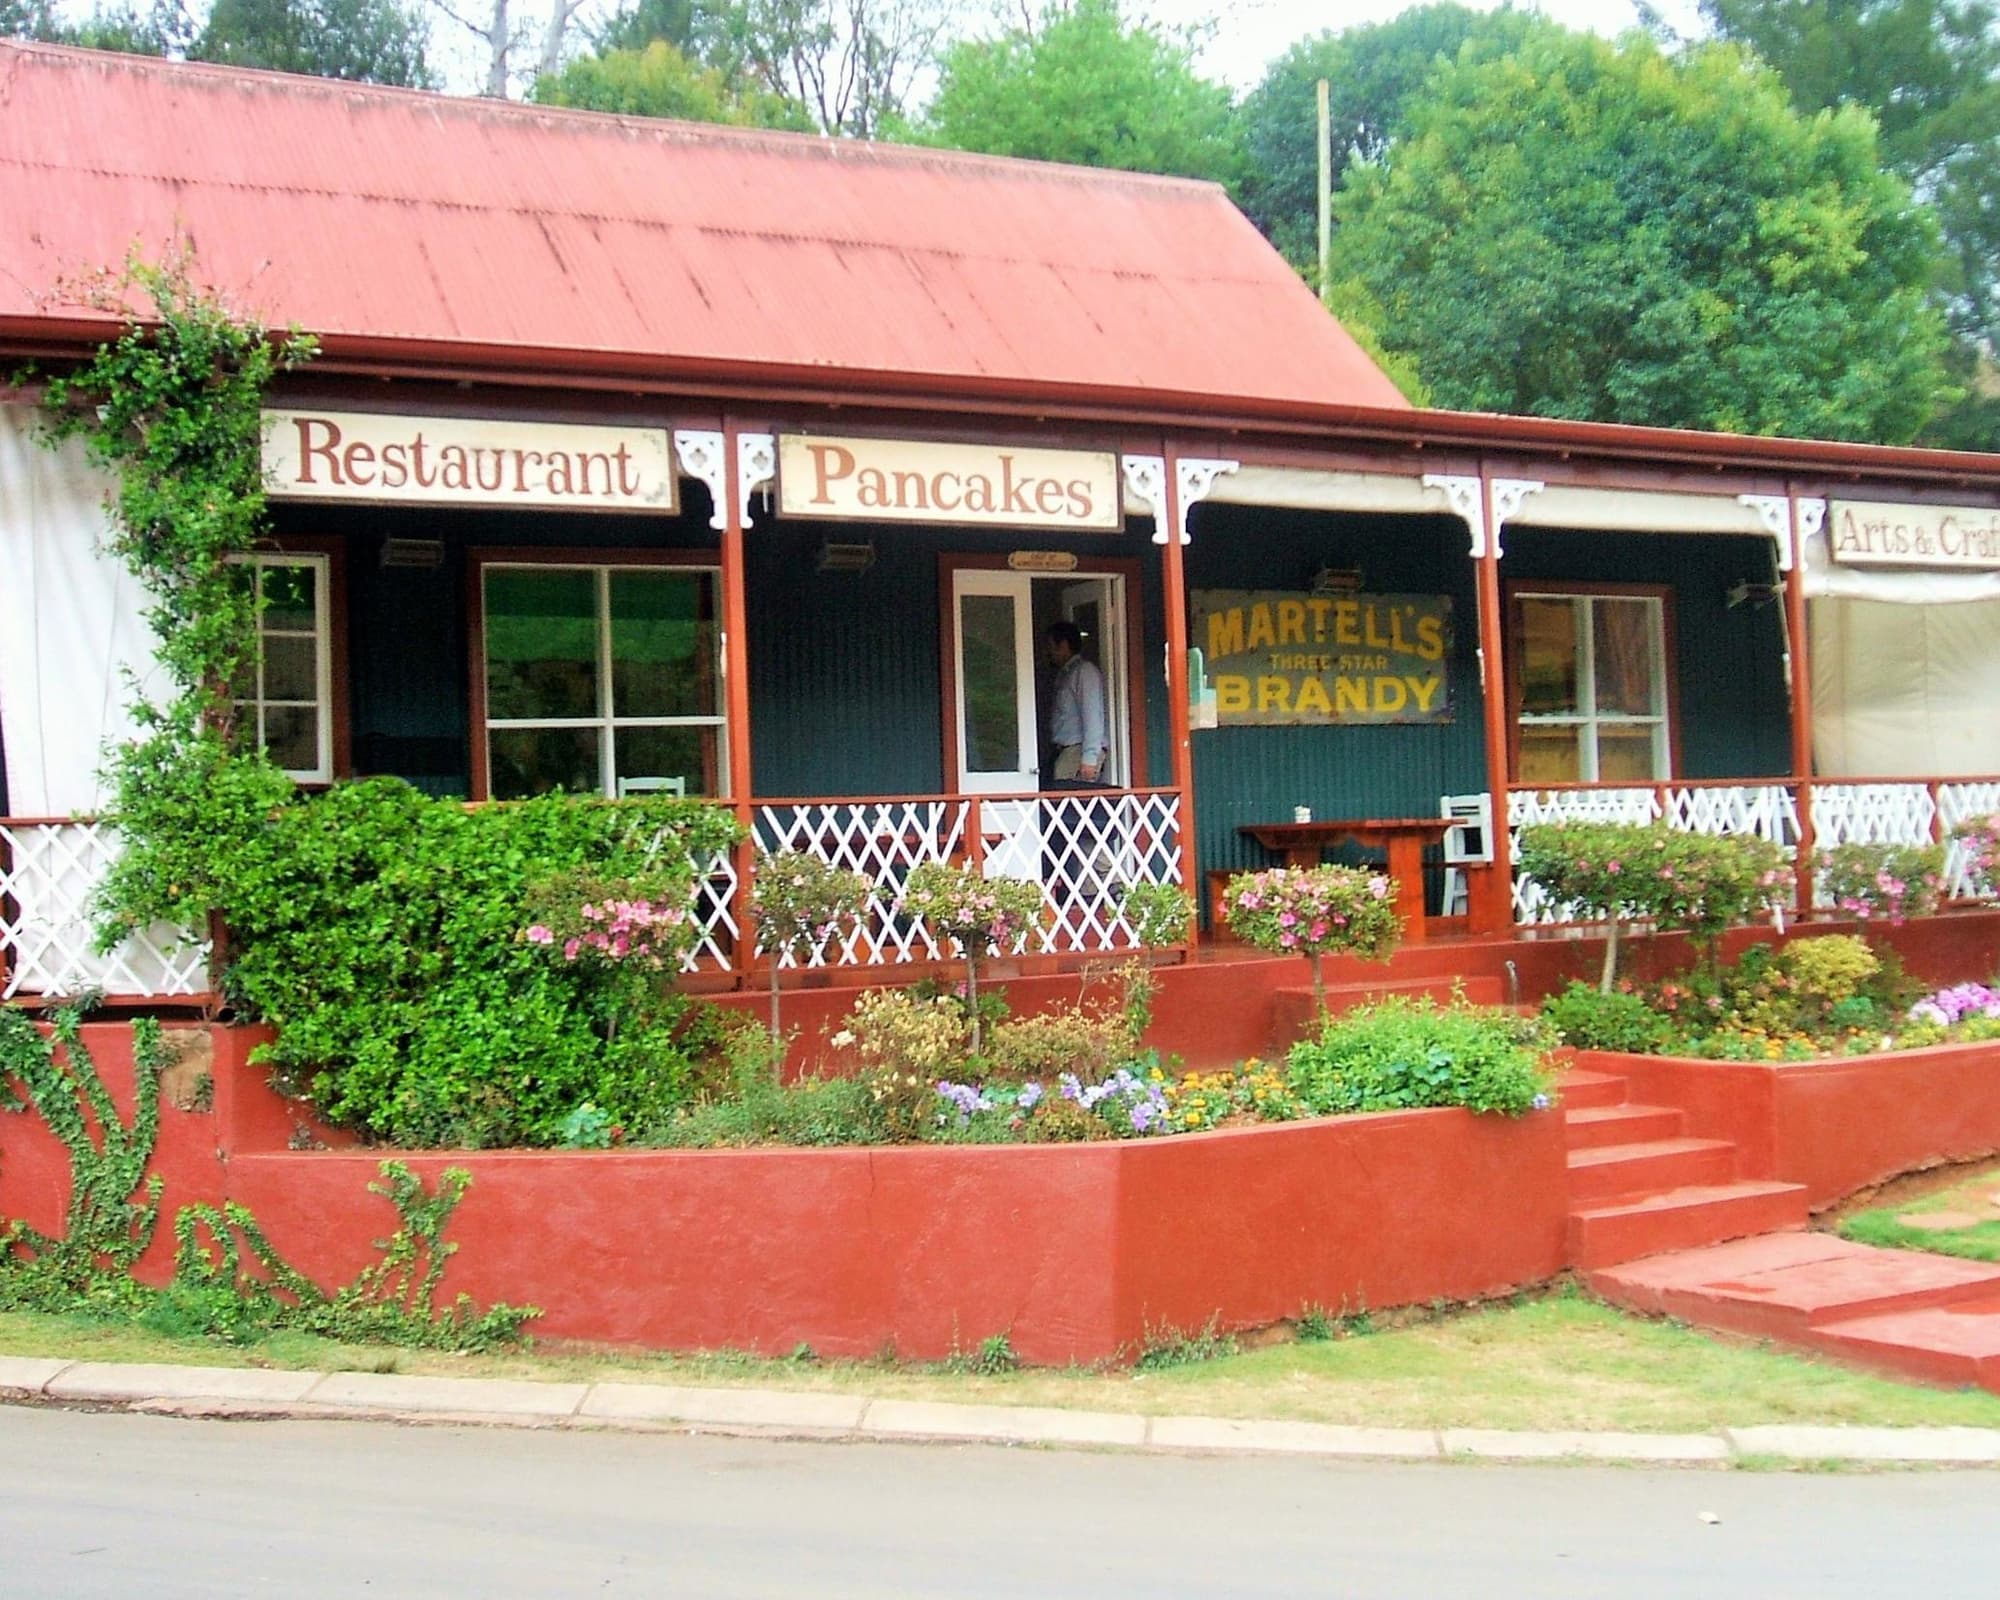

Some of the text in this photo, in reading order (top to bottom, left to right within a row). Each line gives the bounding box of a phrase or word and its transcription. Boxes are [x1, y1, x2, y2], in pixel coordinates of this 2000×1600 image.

[292, 417, 641, 496] Restaurant
[806, 444, 1094, 519] Pancakes
[1838, 508, 1909, 554] Arts
[1914, 525, 1936, 555] &
[1207, 598, 1445, 663] MARTELL'S
[1270, 653, 1388, 671] THREE STAR
[1216, 674, 1441, 713] BRANDY
